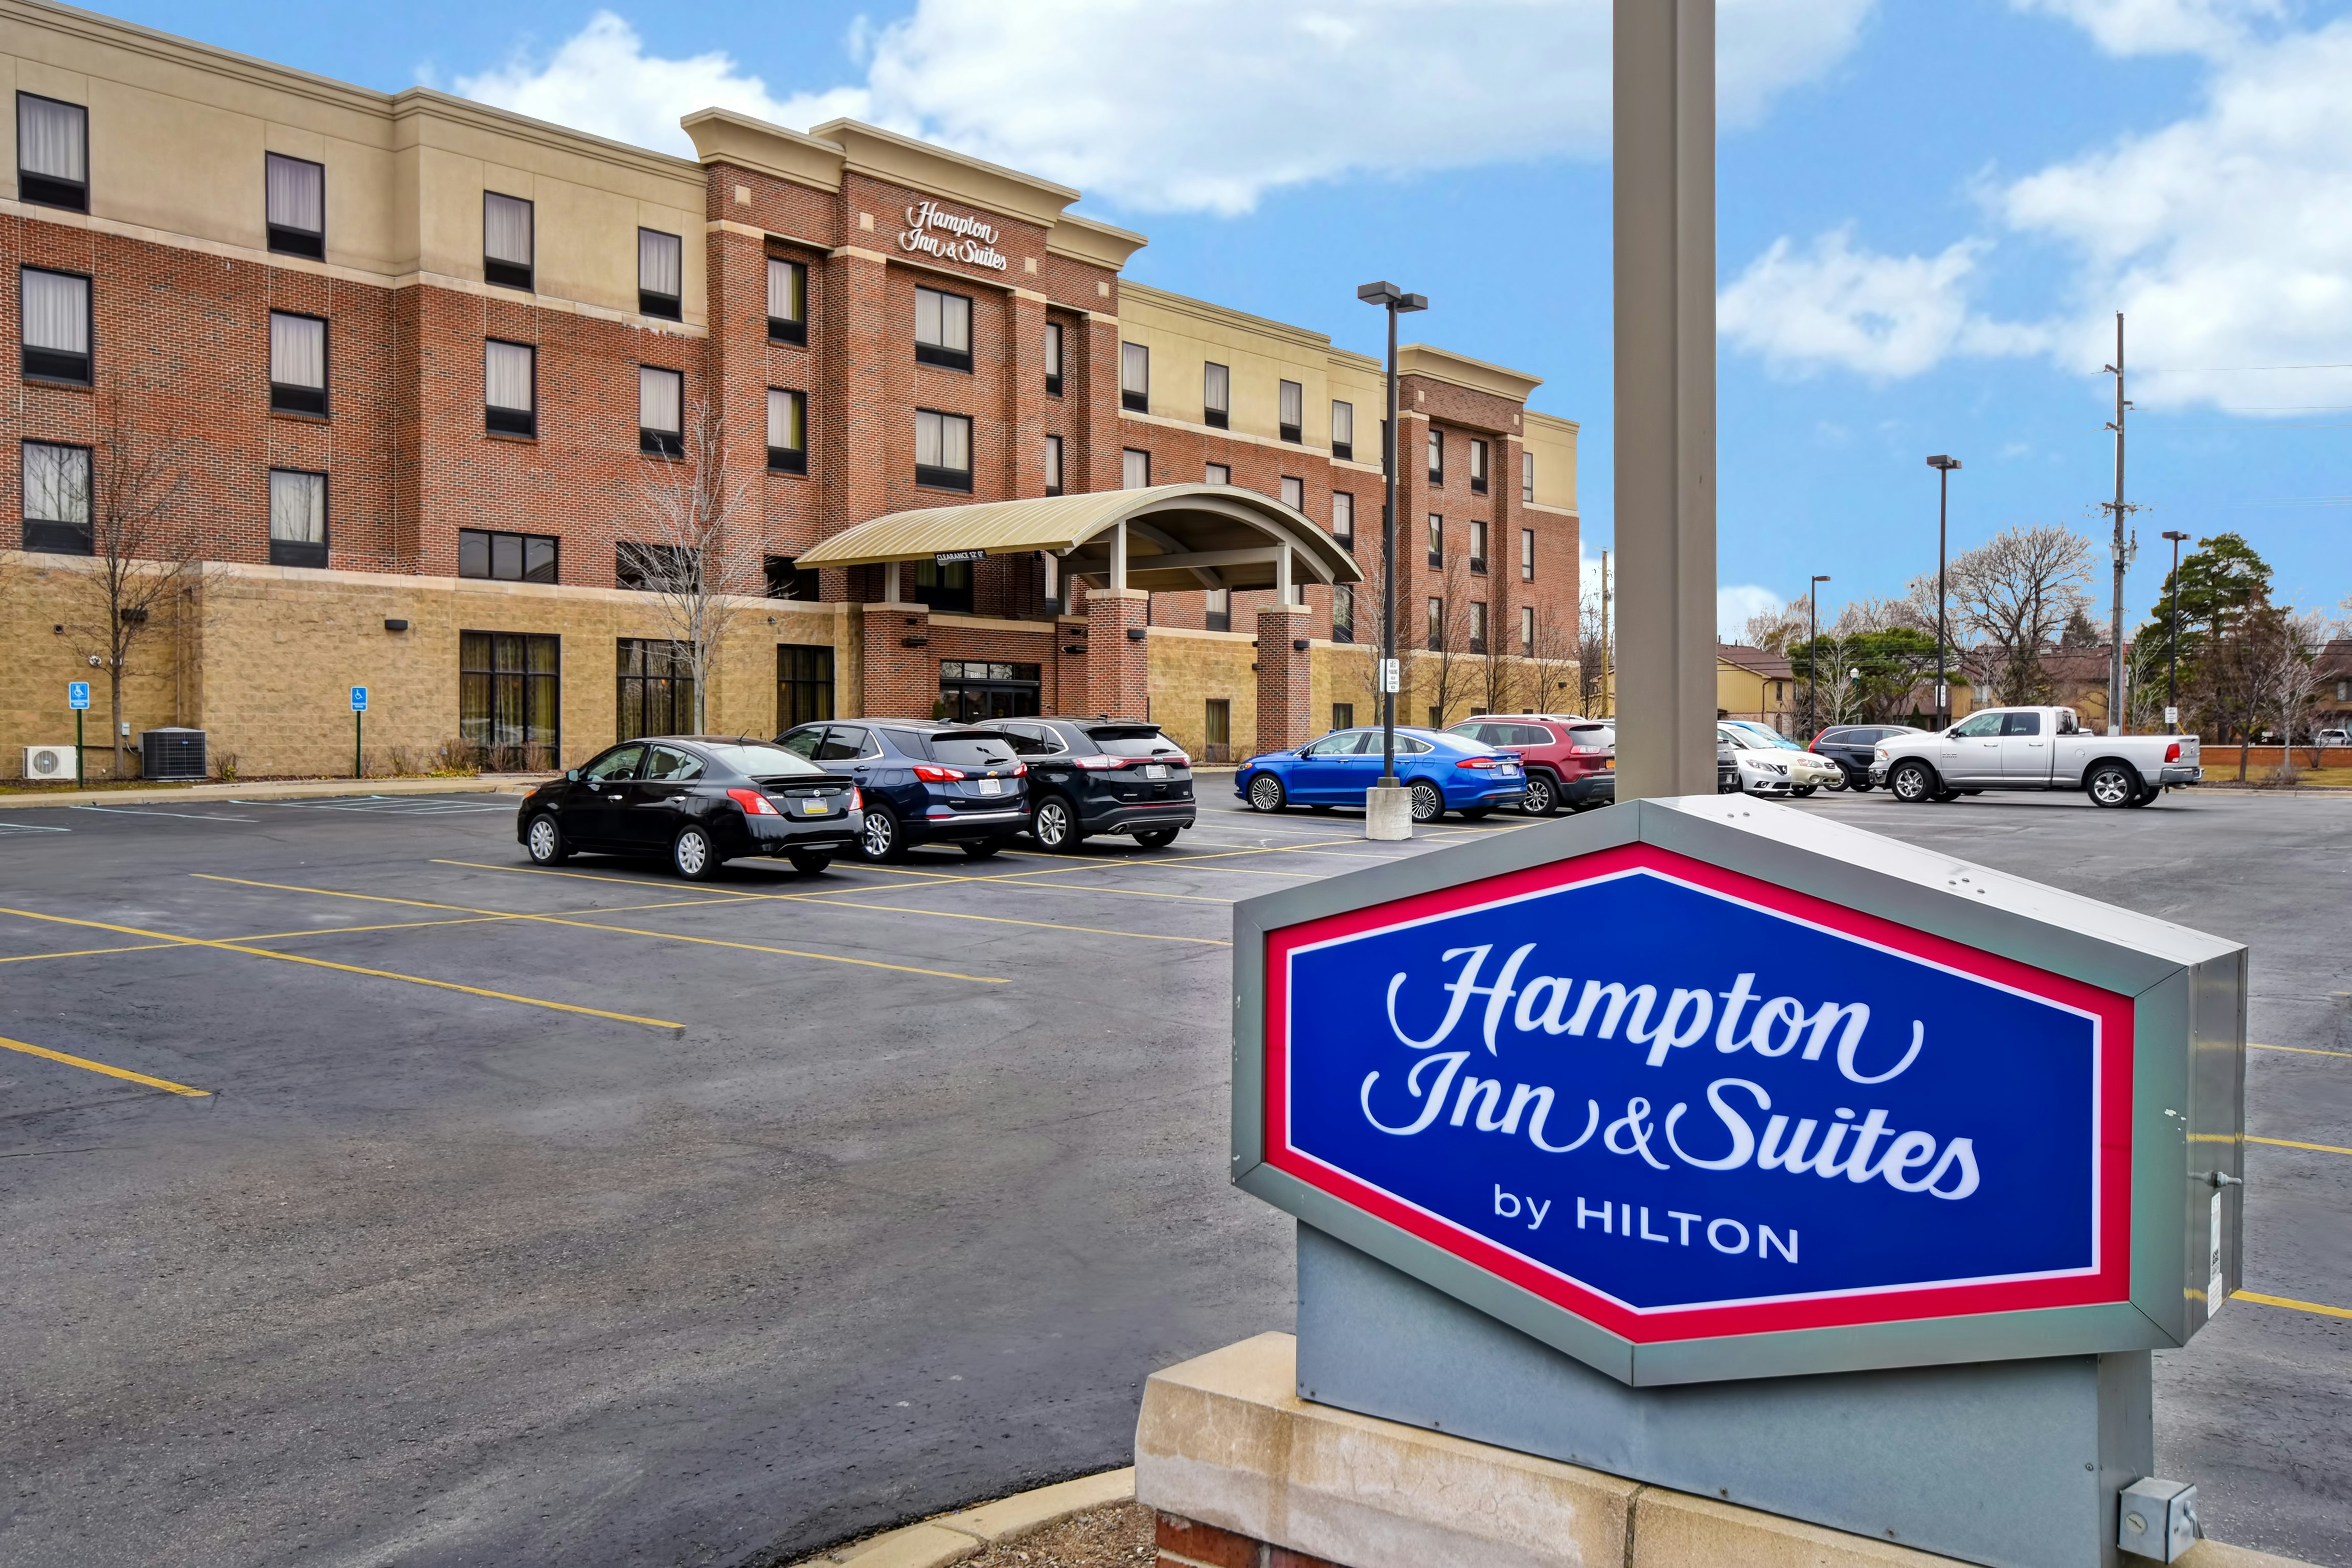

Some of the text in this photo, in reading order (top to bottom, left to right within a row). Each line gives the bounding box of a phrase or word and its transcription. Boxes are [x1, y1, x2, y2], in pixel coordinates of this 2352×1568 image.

[898, 229, 1007, 270] Inn & Suites
[906, 202, 999, 244] Hampton
[936, 552, 969, 560] CLEARANCE
[1387, 943, 1924, 1083] Hampton
[1361, 1052, 1979, 1199] Inn & Suites
[1495, 1184, 1797, 1263] by HILTON
